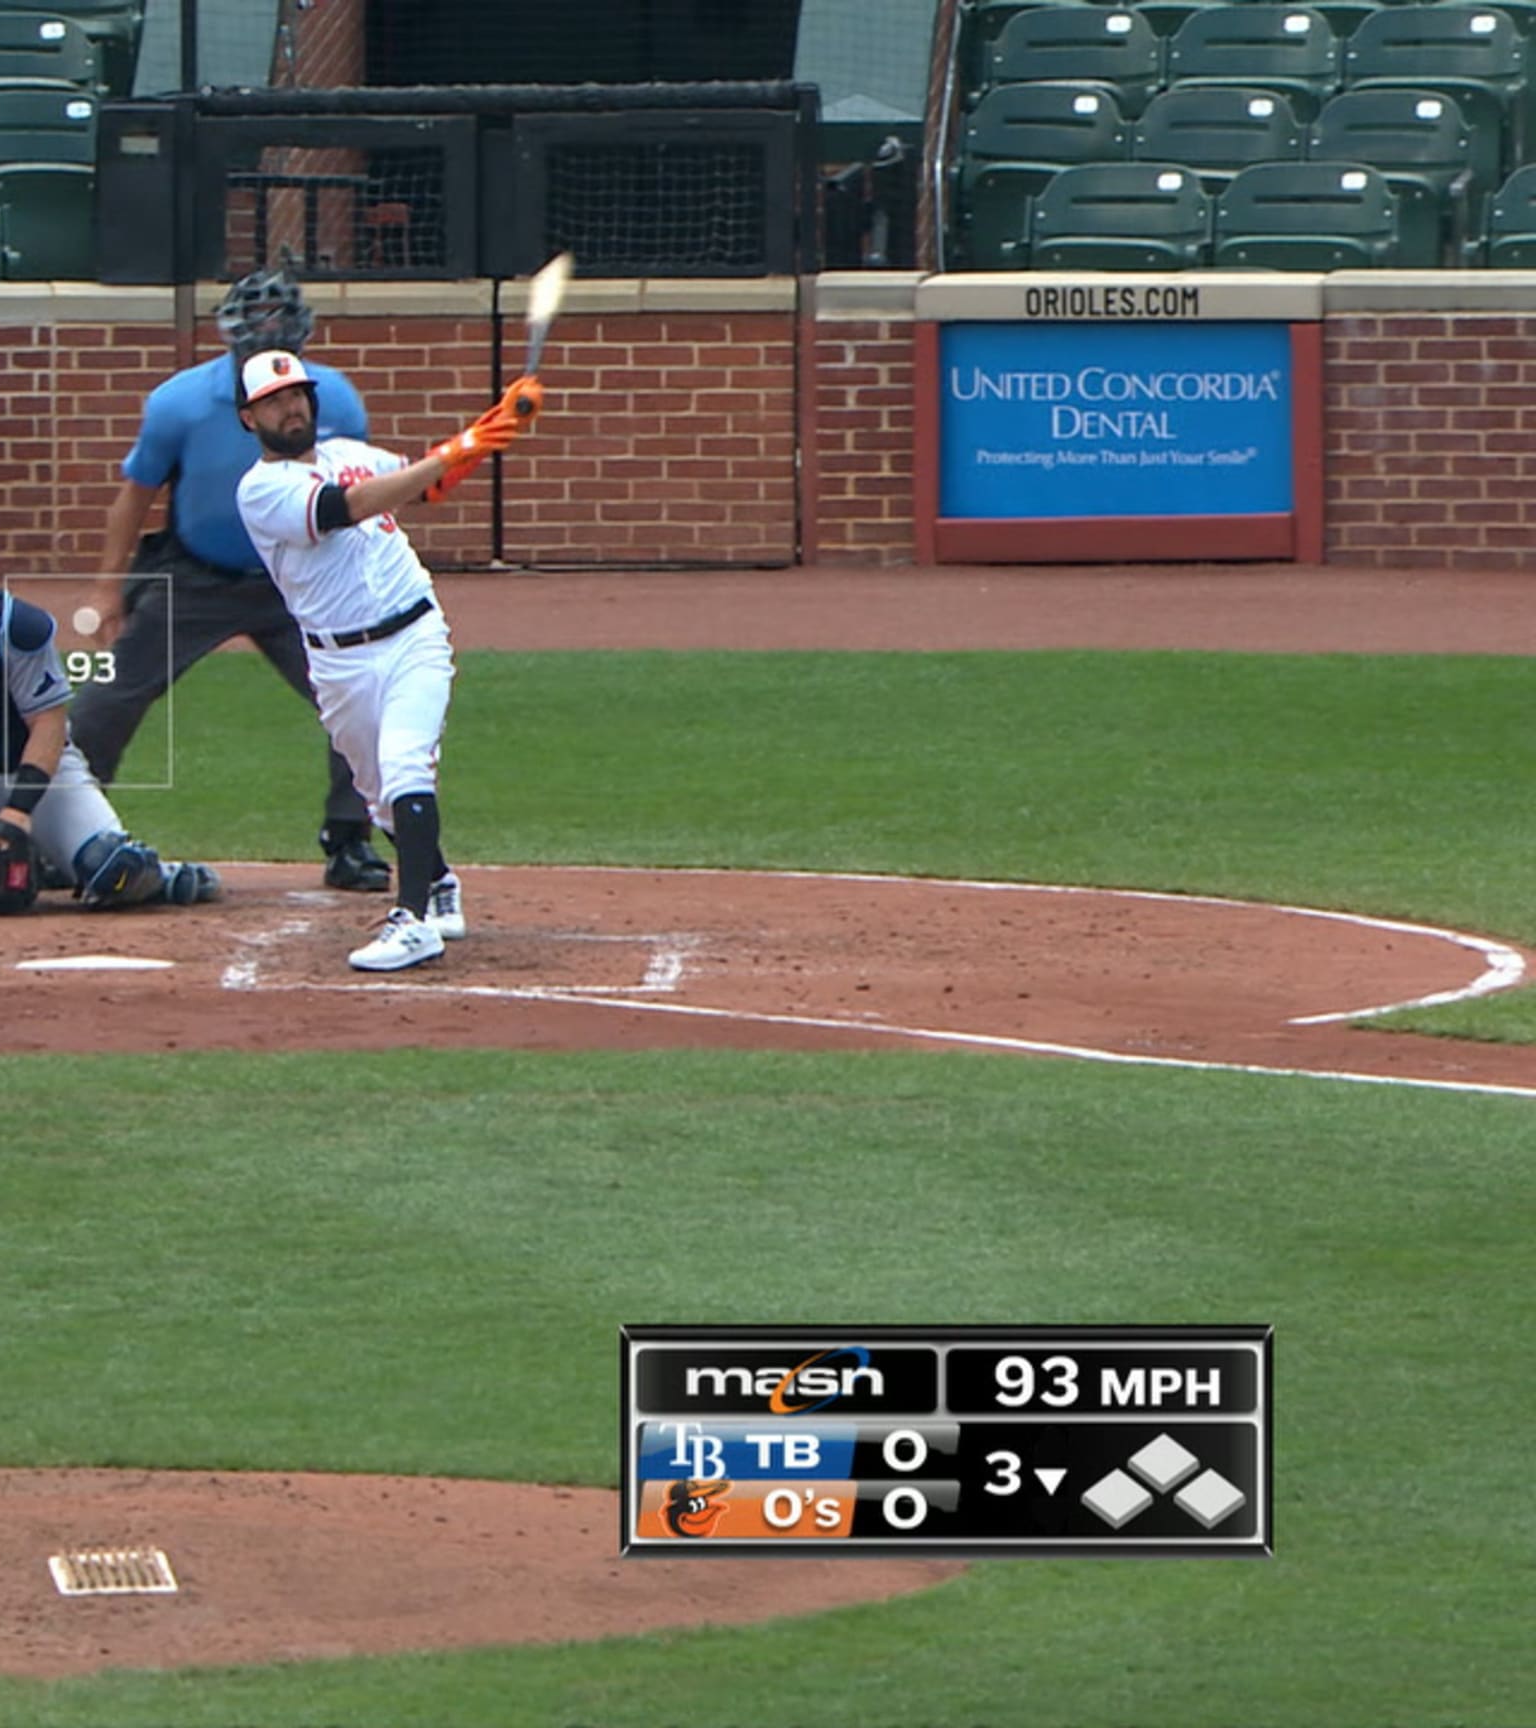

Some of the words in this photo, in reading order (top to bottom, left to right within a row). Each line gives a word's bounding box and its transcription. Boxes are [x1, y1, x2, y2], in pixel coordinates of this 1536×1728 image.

[1025, 287, 1200, 317] ORIOLES.COM
[951, 366, 1072, 400] UNITED
[1052, 405, 1177, 440] DENTAL
[976, 449, 1055, 470] Protecting
[1057, 449, 1098, 465] More
[1102, 449, 1138, 465] Than
[1139, 449, 1167, 466] Just
[1170, 449, 1205, 465] Your
